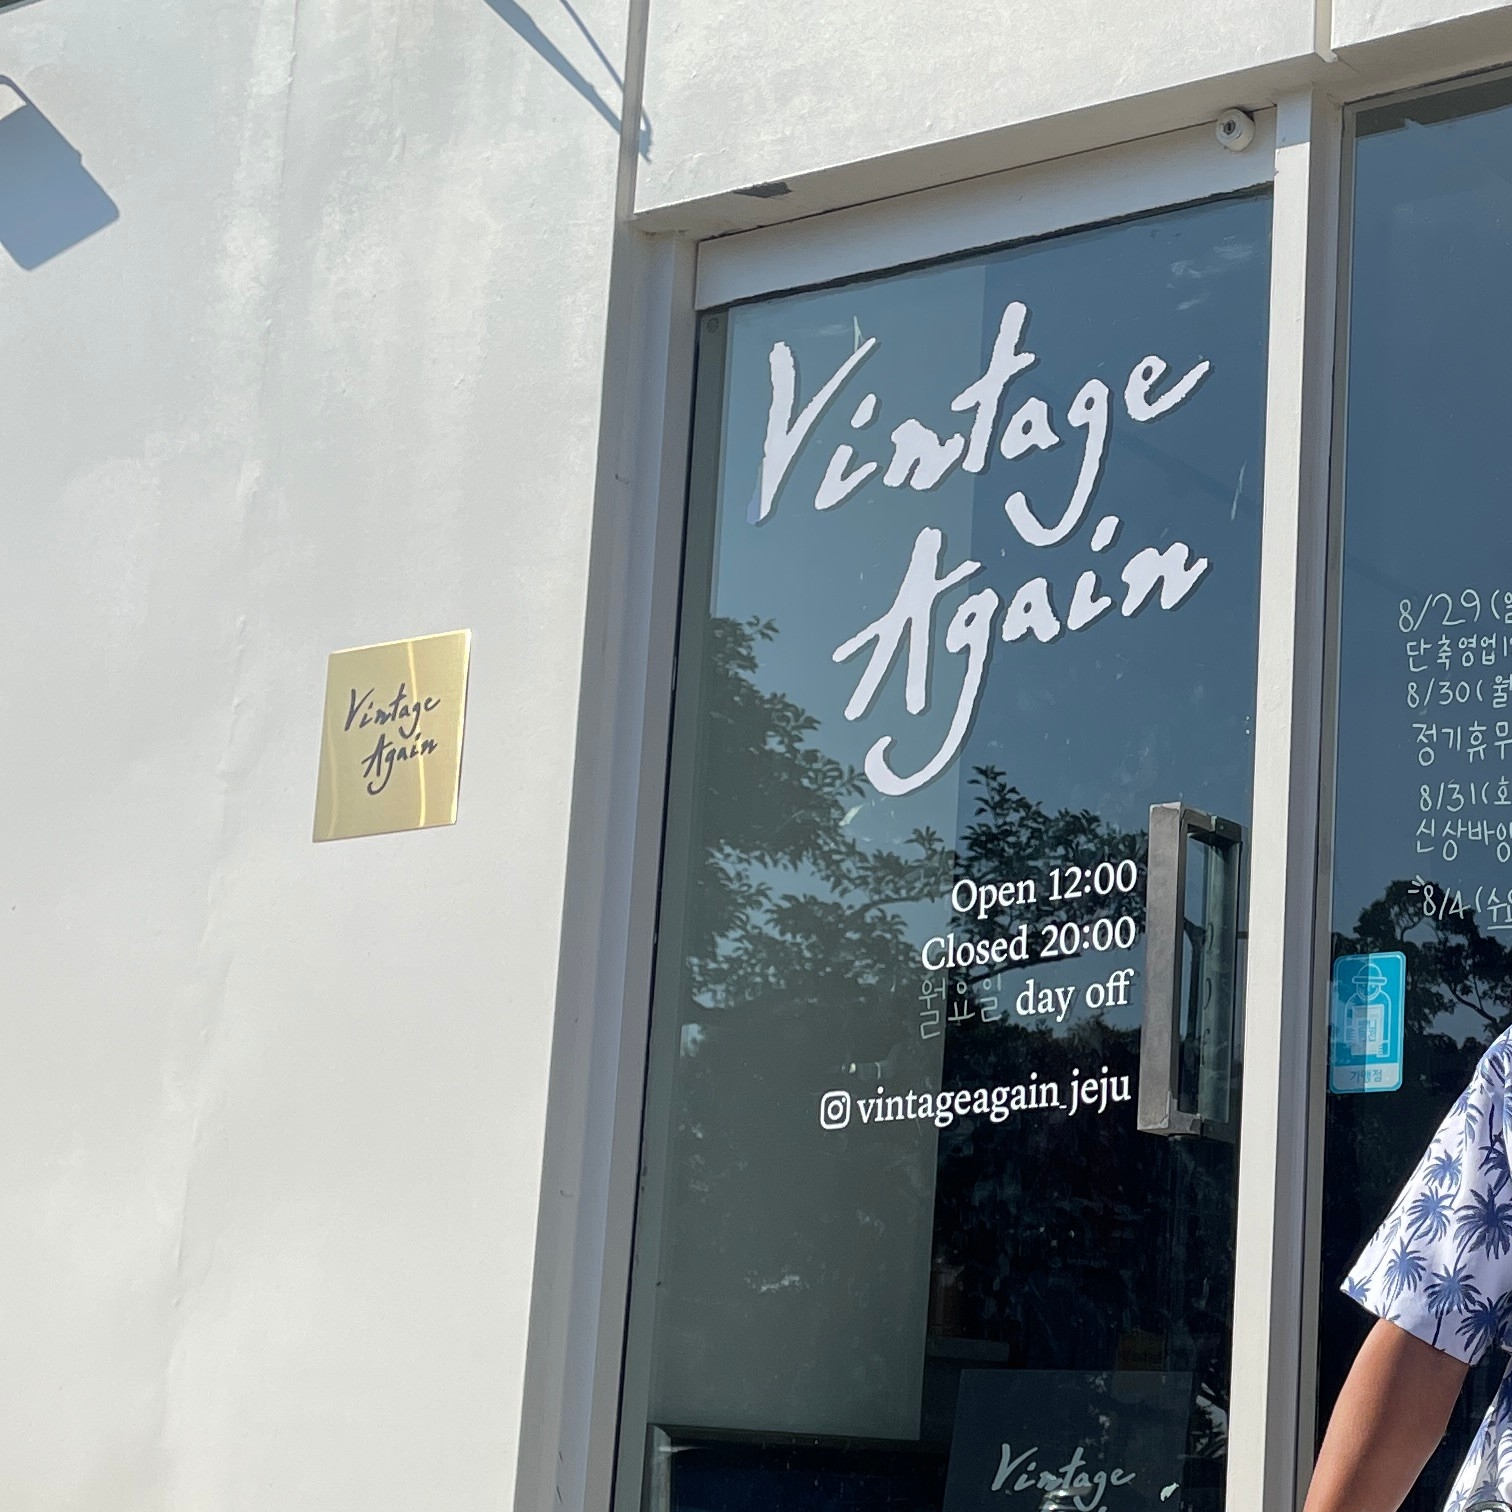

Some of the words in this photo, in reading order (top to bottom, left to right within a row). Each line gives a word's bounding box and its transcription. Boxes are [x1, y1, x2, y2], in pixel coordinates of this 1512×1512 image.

[747, 301, 1211, 547] Vintage
[832, 516, 1208, 796] Again
[345, 683, 441, 739] Vintage
[361, 732, 438, 795] Again
[951, 878, 1037, 919] Open
[1048, 859, 1137, 902] 12:00
[921, 925, 1029, 971] Closed
[1040, 915, 1136, 959] 20:00
[917, 976, 1001, 1040] 월요일
[1015, 979, 1075, 1022] day
[1085, 968, 1135, 1009] off
[856, 1065, 1132, 1127] vintageagain_jeju
[991, 1443, 1136, 1512] Vintage
